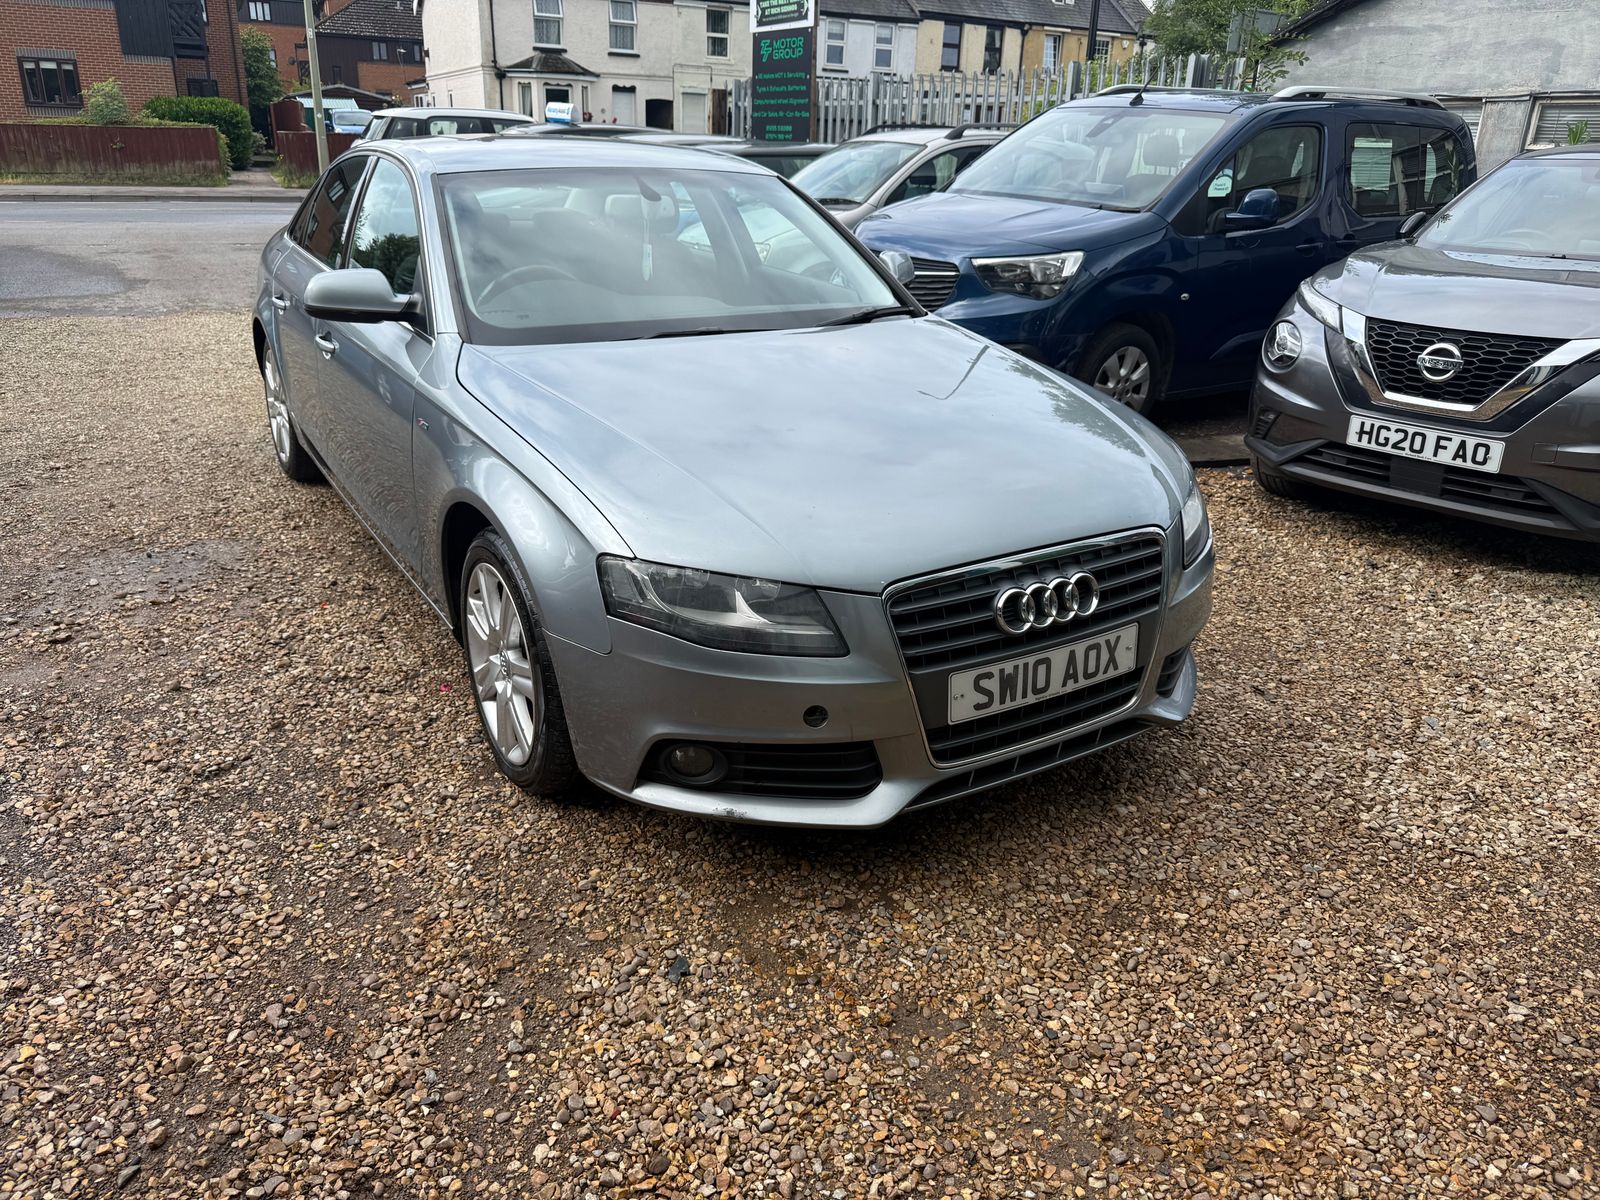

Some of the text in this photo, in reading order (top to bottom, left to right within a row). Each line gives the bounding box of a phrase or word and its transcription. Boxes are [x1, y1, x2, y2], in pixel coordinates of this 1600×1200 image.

[773, 37, 804, 49] MOTOR
[773, 47, 804, 60] GROUP
[1421, 357, 1458, 370] NISSAN
[1357, 421, 1491, 466] HG20 FAO
[973, 635, 1121, 711] SW10 AOX
